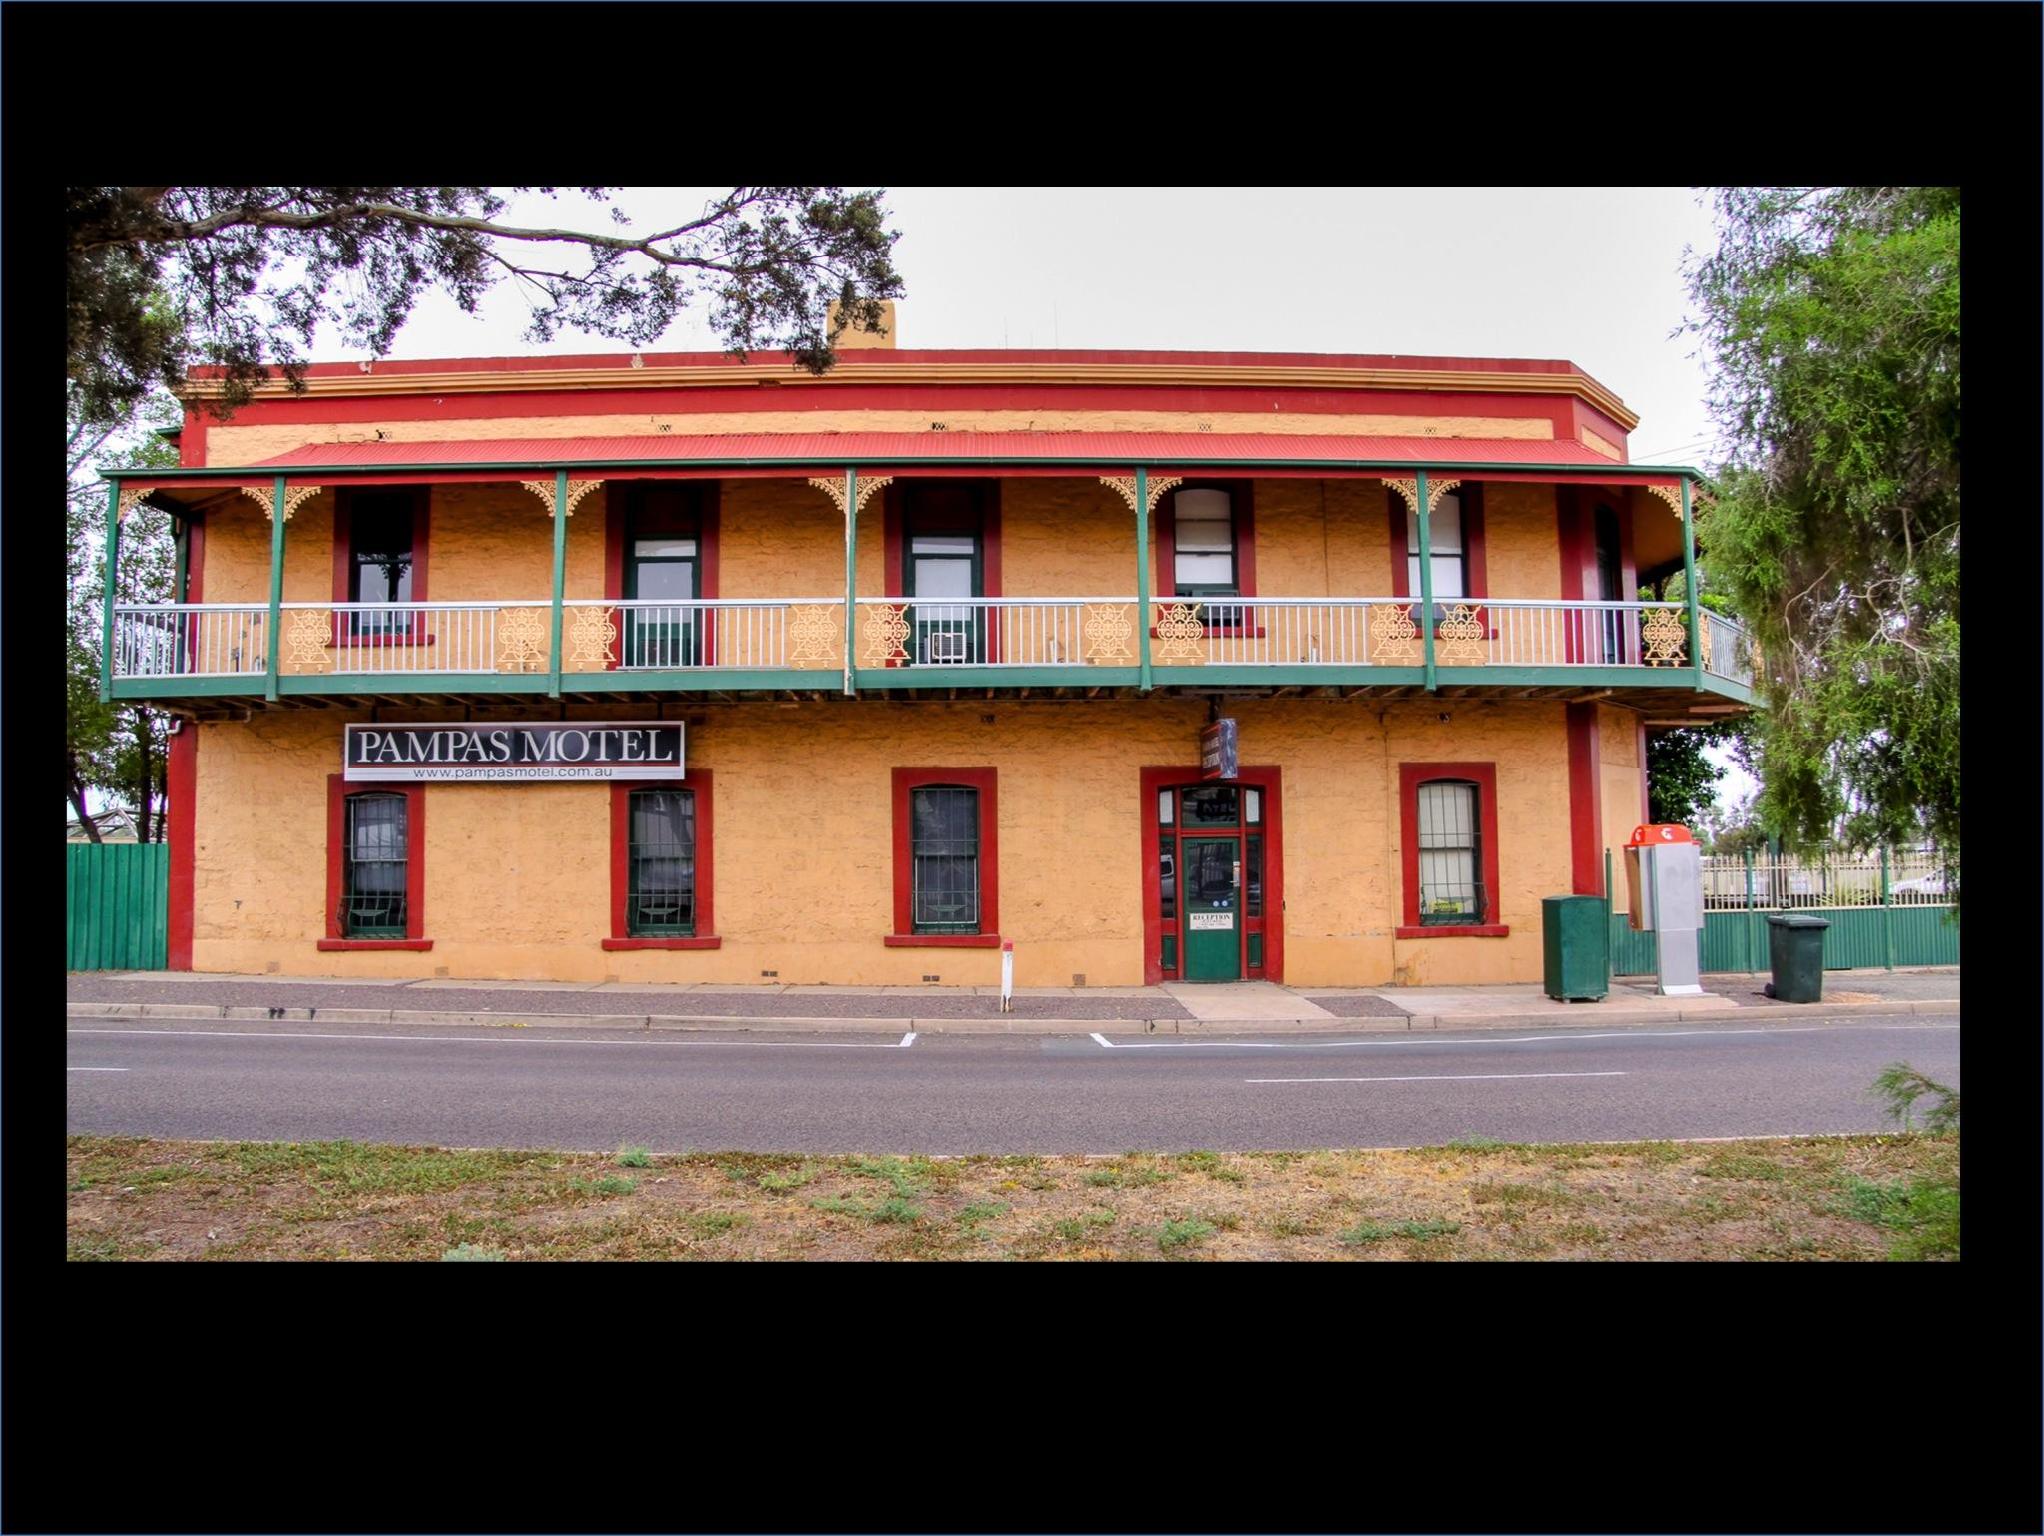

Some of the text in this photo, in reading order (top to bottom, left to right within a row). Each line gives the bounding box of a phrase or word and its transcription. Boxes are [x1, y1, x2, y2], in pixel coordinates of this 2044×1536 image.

[357, 730, 672, 763] PAMPAS MOTEL
[413, 767, 613, 779] www.pampasmotel.com.au
